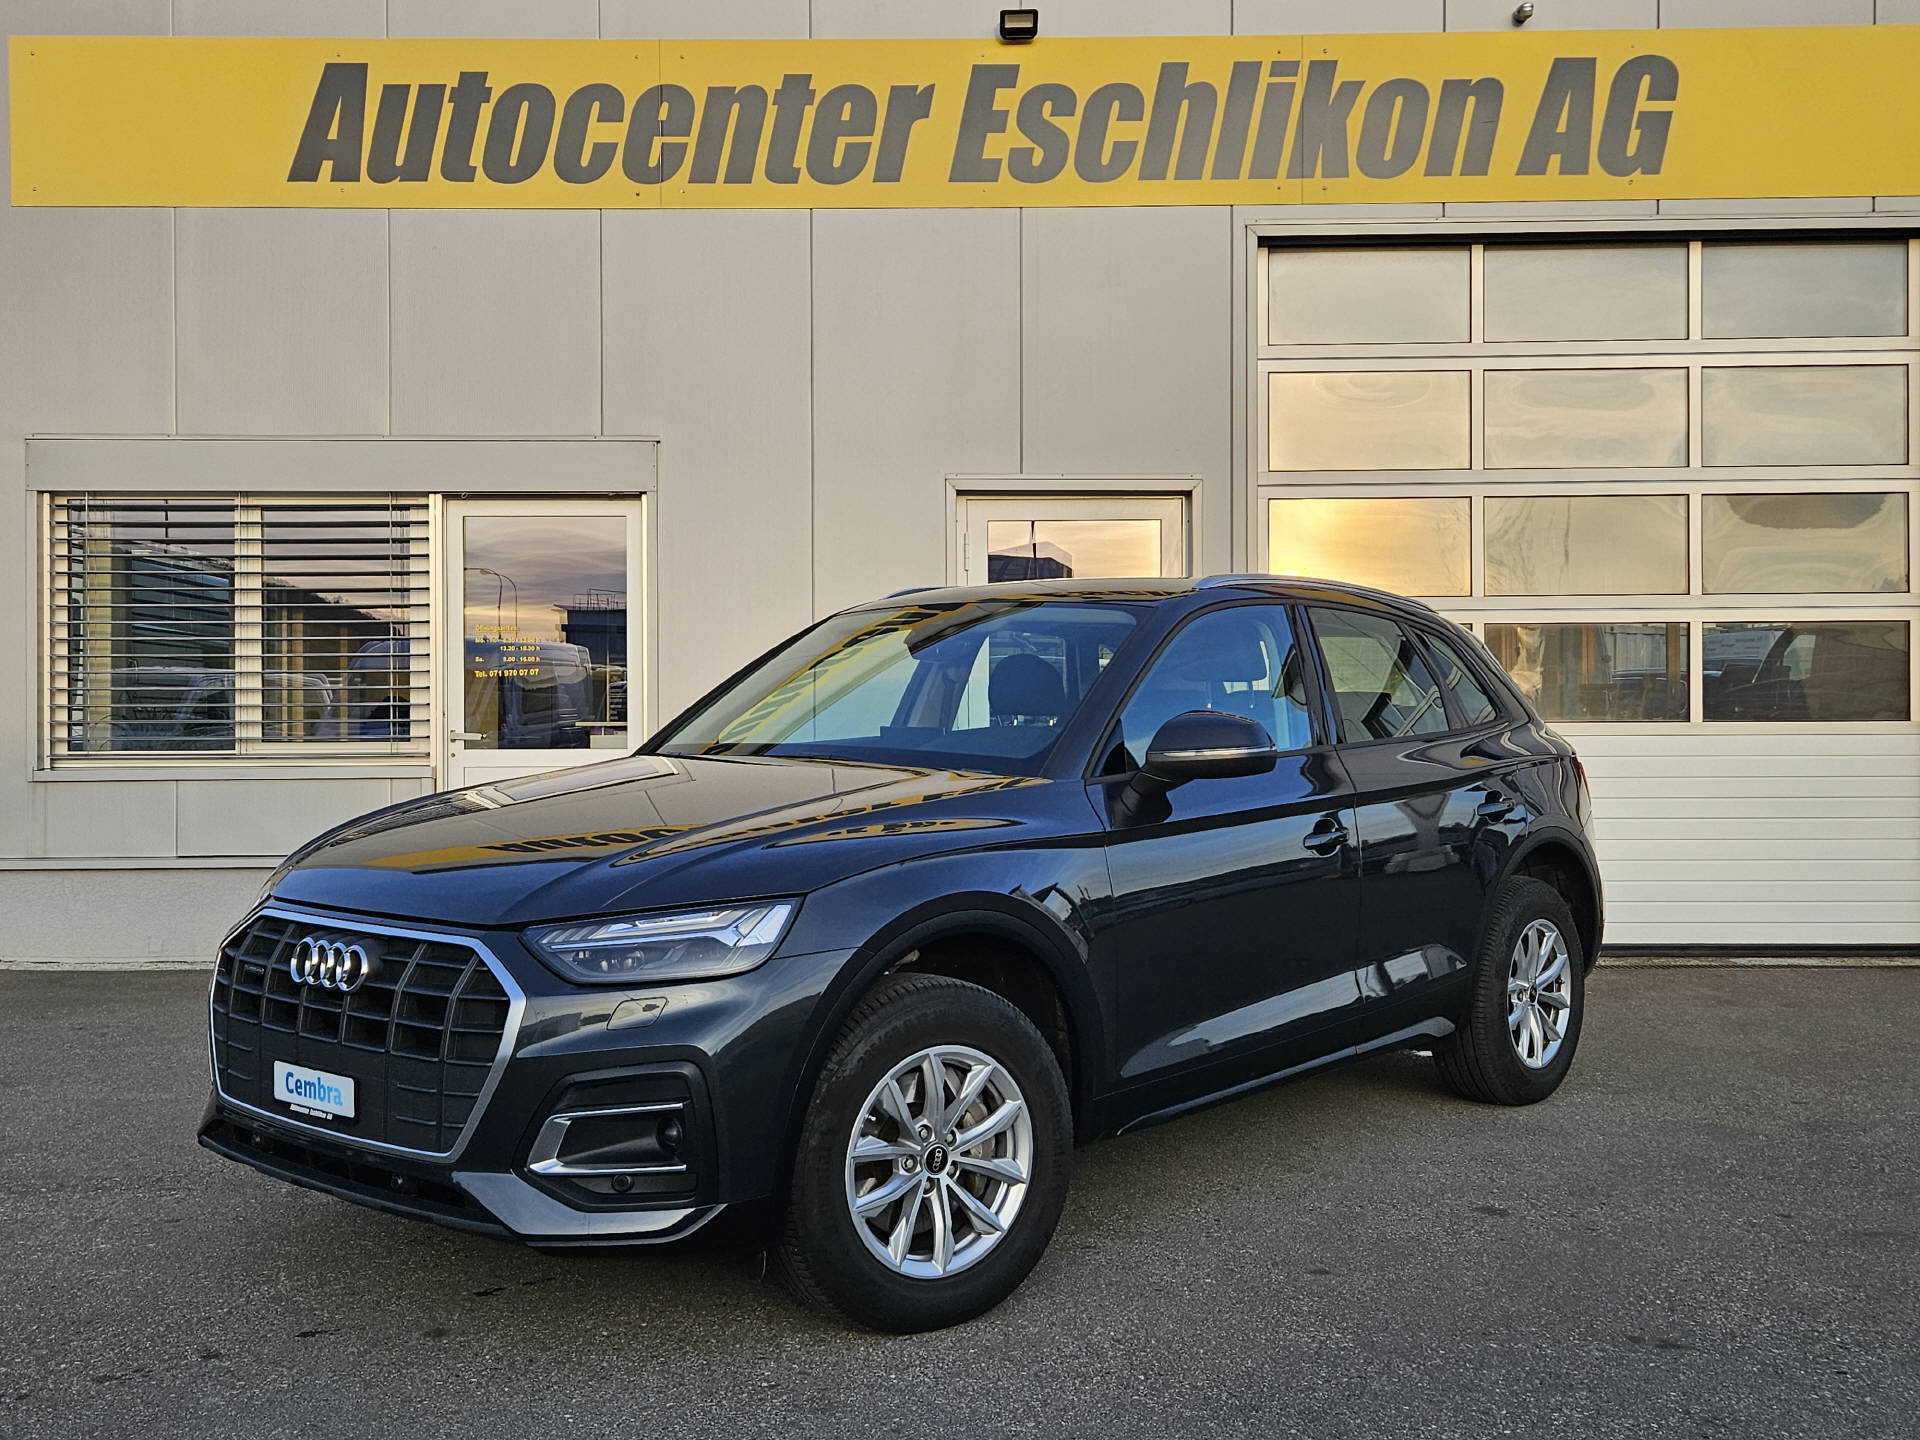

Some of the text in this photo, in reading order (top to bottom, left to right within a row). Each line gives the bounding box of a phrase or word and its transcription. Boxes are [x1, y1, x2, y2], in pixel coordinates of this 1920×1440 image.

[287, 54, 1679, 185] Autocenter Eschlikon AG
[474, 670, 488, 678] Tel.
[529, 668, 539, 676] 07
[285, 1071, 343, 1106] Cembra
